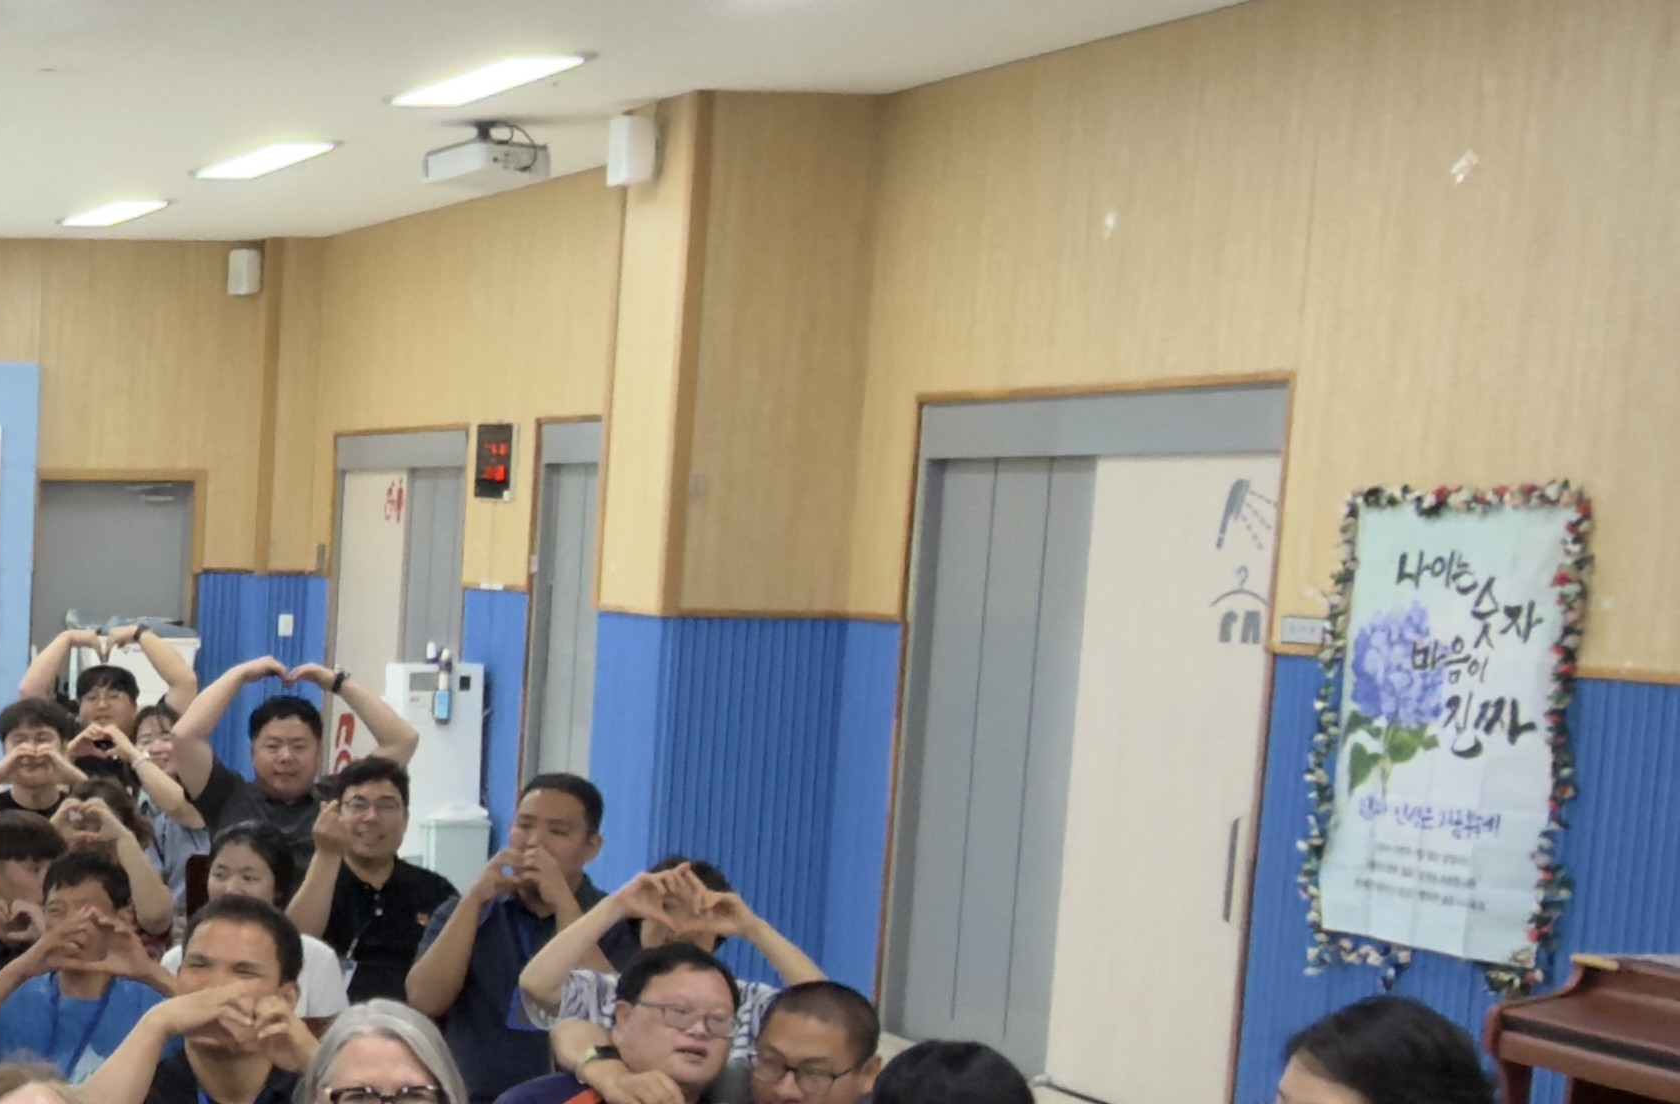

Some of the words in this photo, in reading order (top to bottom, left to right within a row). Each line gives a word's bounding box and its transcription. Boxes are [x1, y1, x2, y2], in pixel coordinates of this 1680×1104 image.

[1396, 549, 1479, 596] 나이는
[1470, 576, 1545, 650] 숫자
[1410, 635, 1490, 685] 마음이
[1443, 690, 1538, 760] 진짜
